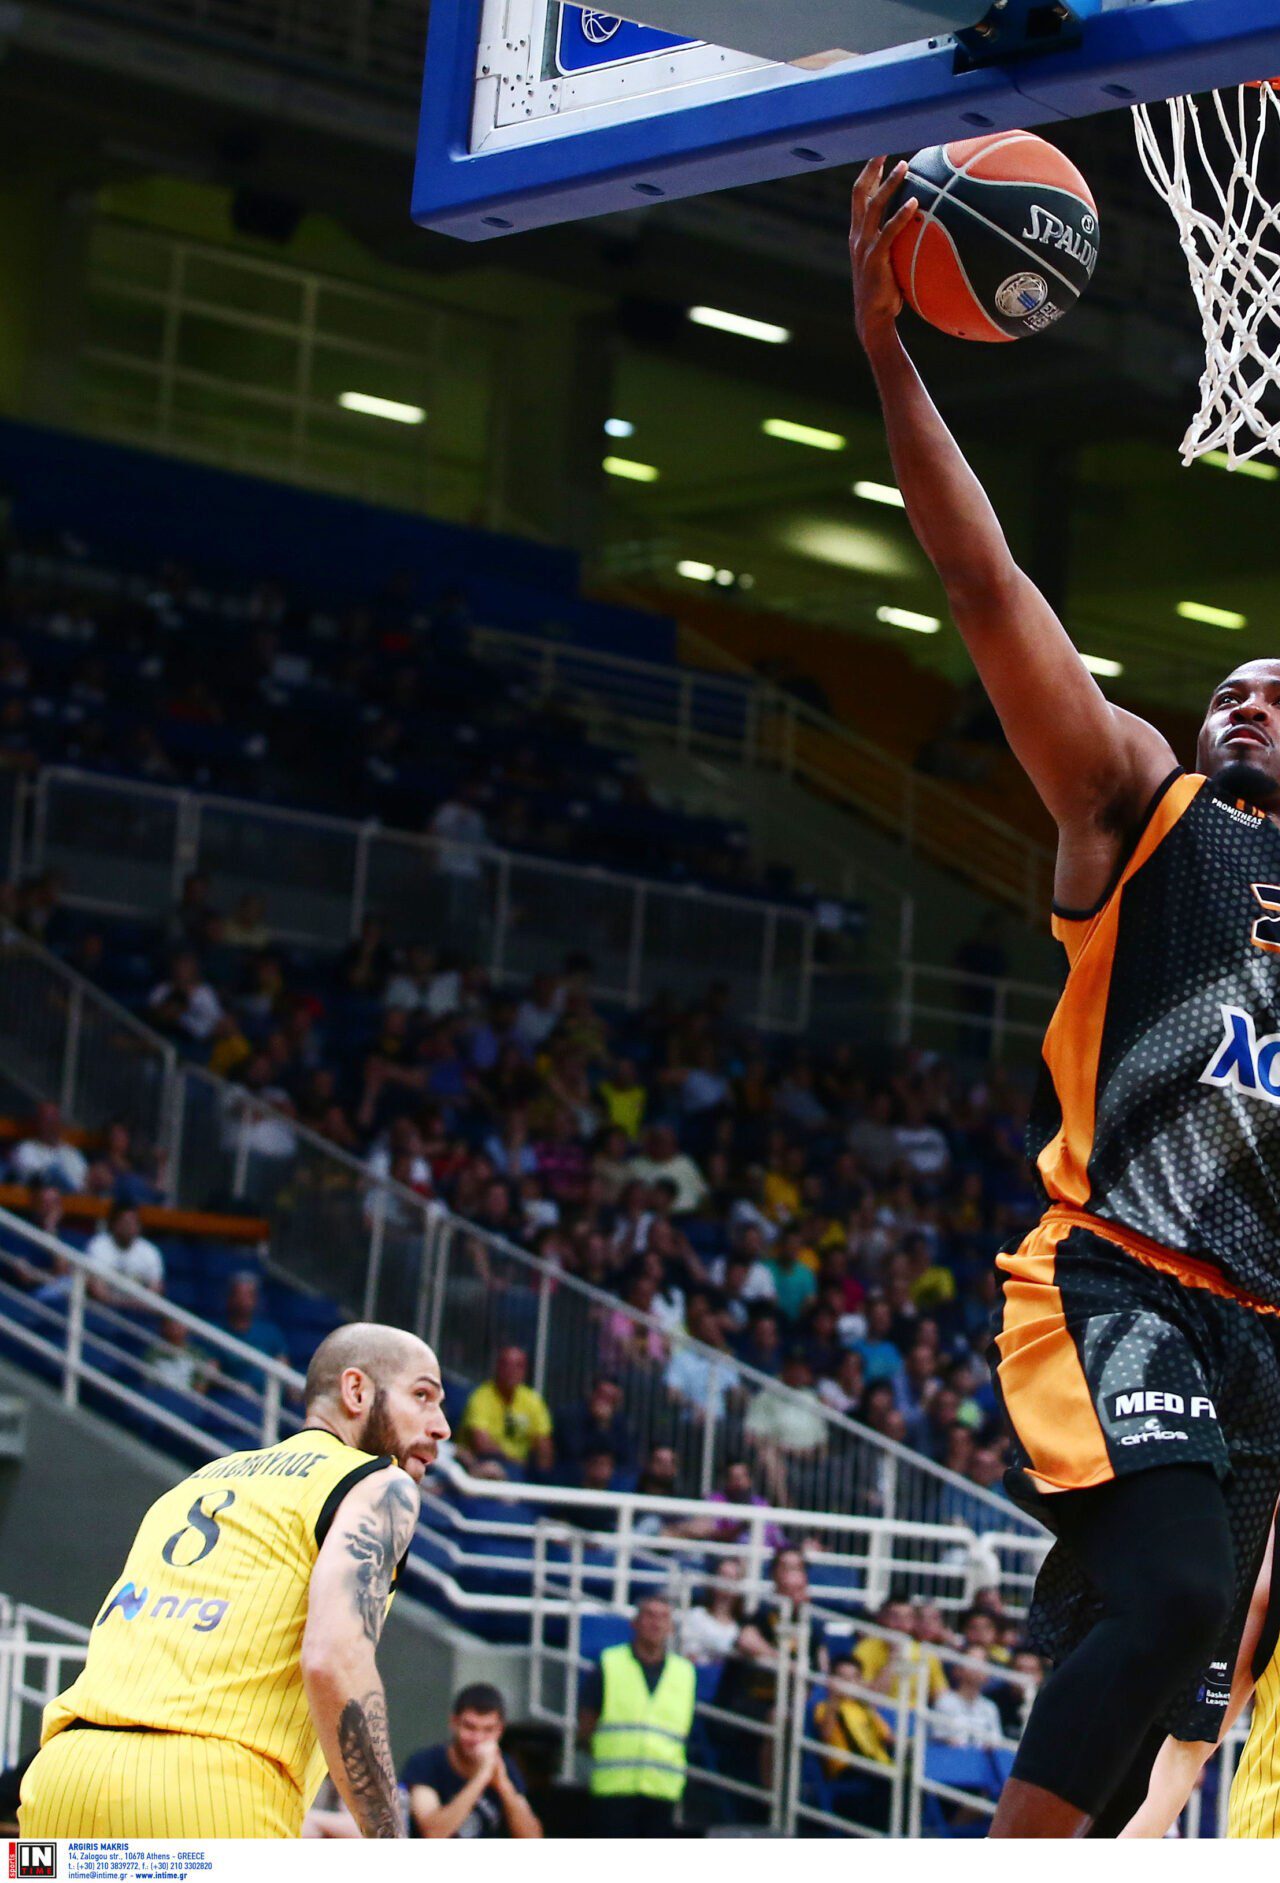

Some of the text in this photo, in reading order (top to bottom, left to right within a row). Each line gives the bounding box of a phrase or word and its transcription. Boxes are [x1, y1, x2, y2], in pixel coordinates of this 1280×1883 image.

[1211, 797, 1263, 825] PROMITHEAS
[1115, 1391, 1185, 1416] MED
[161, 1489, 236, 1568] 8
[150, 1595, 230, 1632] nrg
